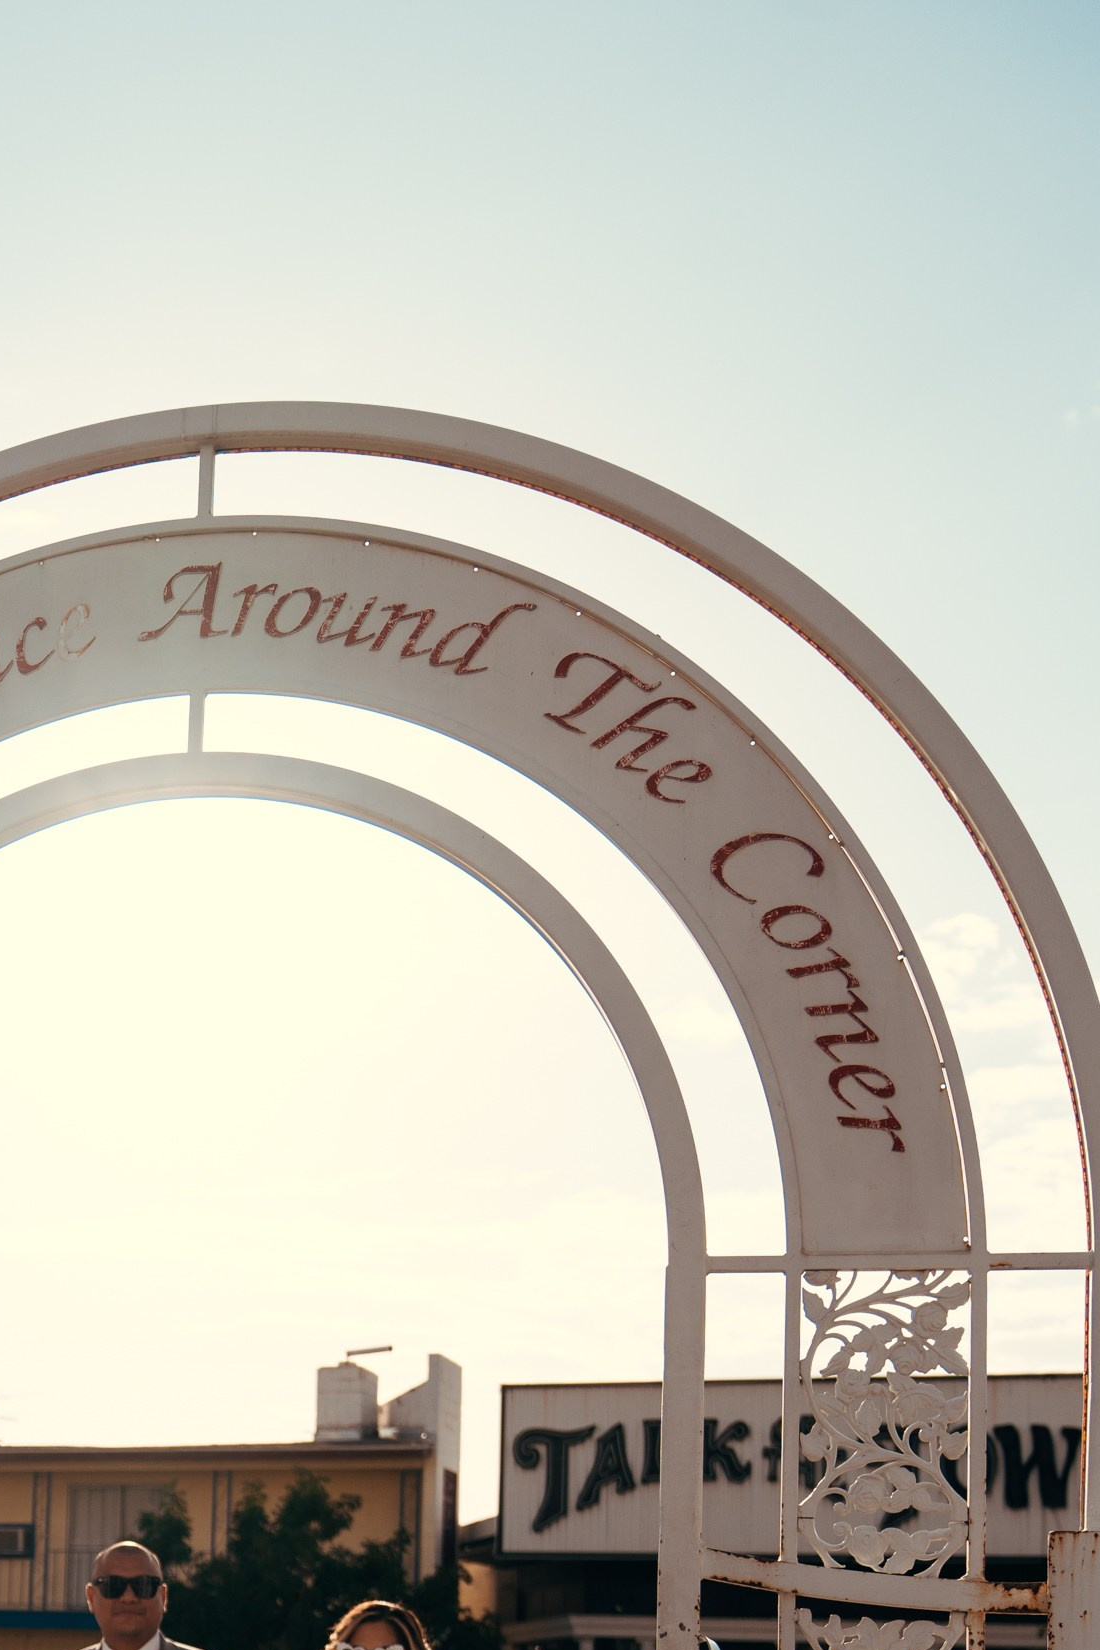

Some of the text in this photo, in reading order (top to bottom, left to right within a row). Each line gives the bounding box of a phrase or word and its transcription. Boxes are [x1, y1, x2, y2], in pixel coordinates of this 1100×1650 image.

[138, 561, 536, 676] Around
[544, 651, 714, 804] The
[711, 832, 905, 1154] Corner
